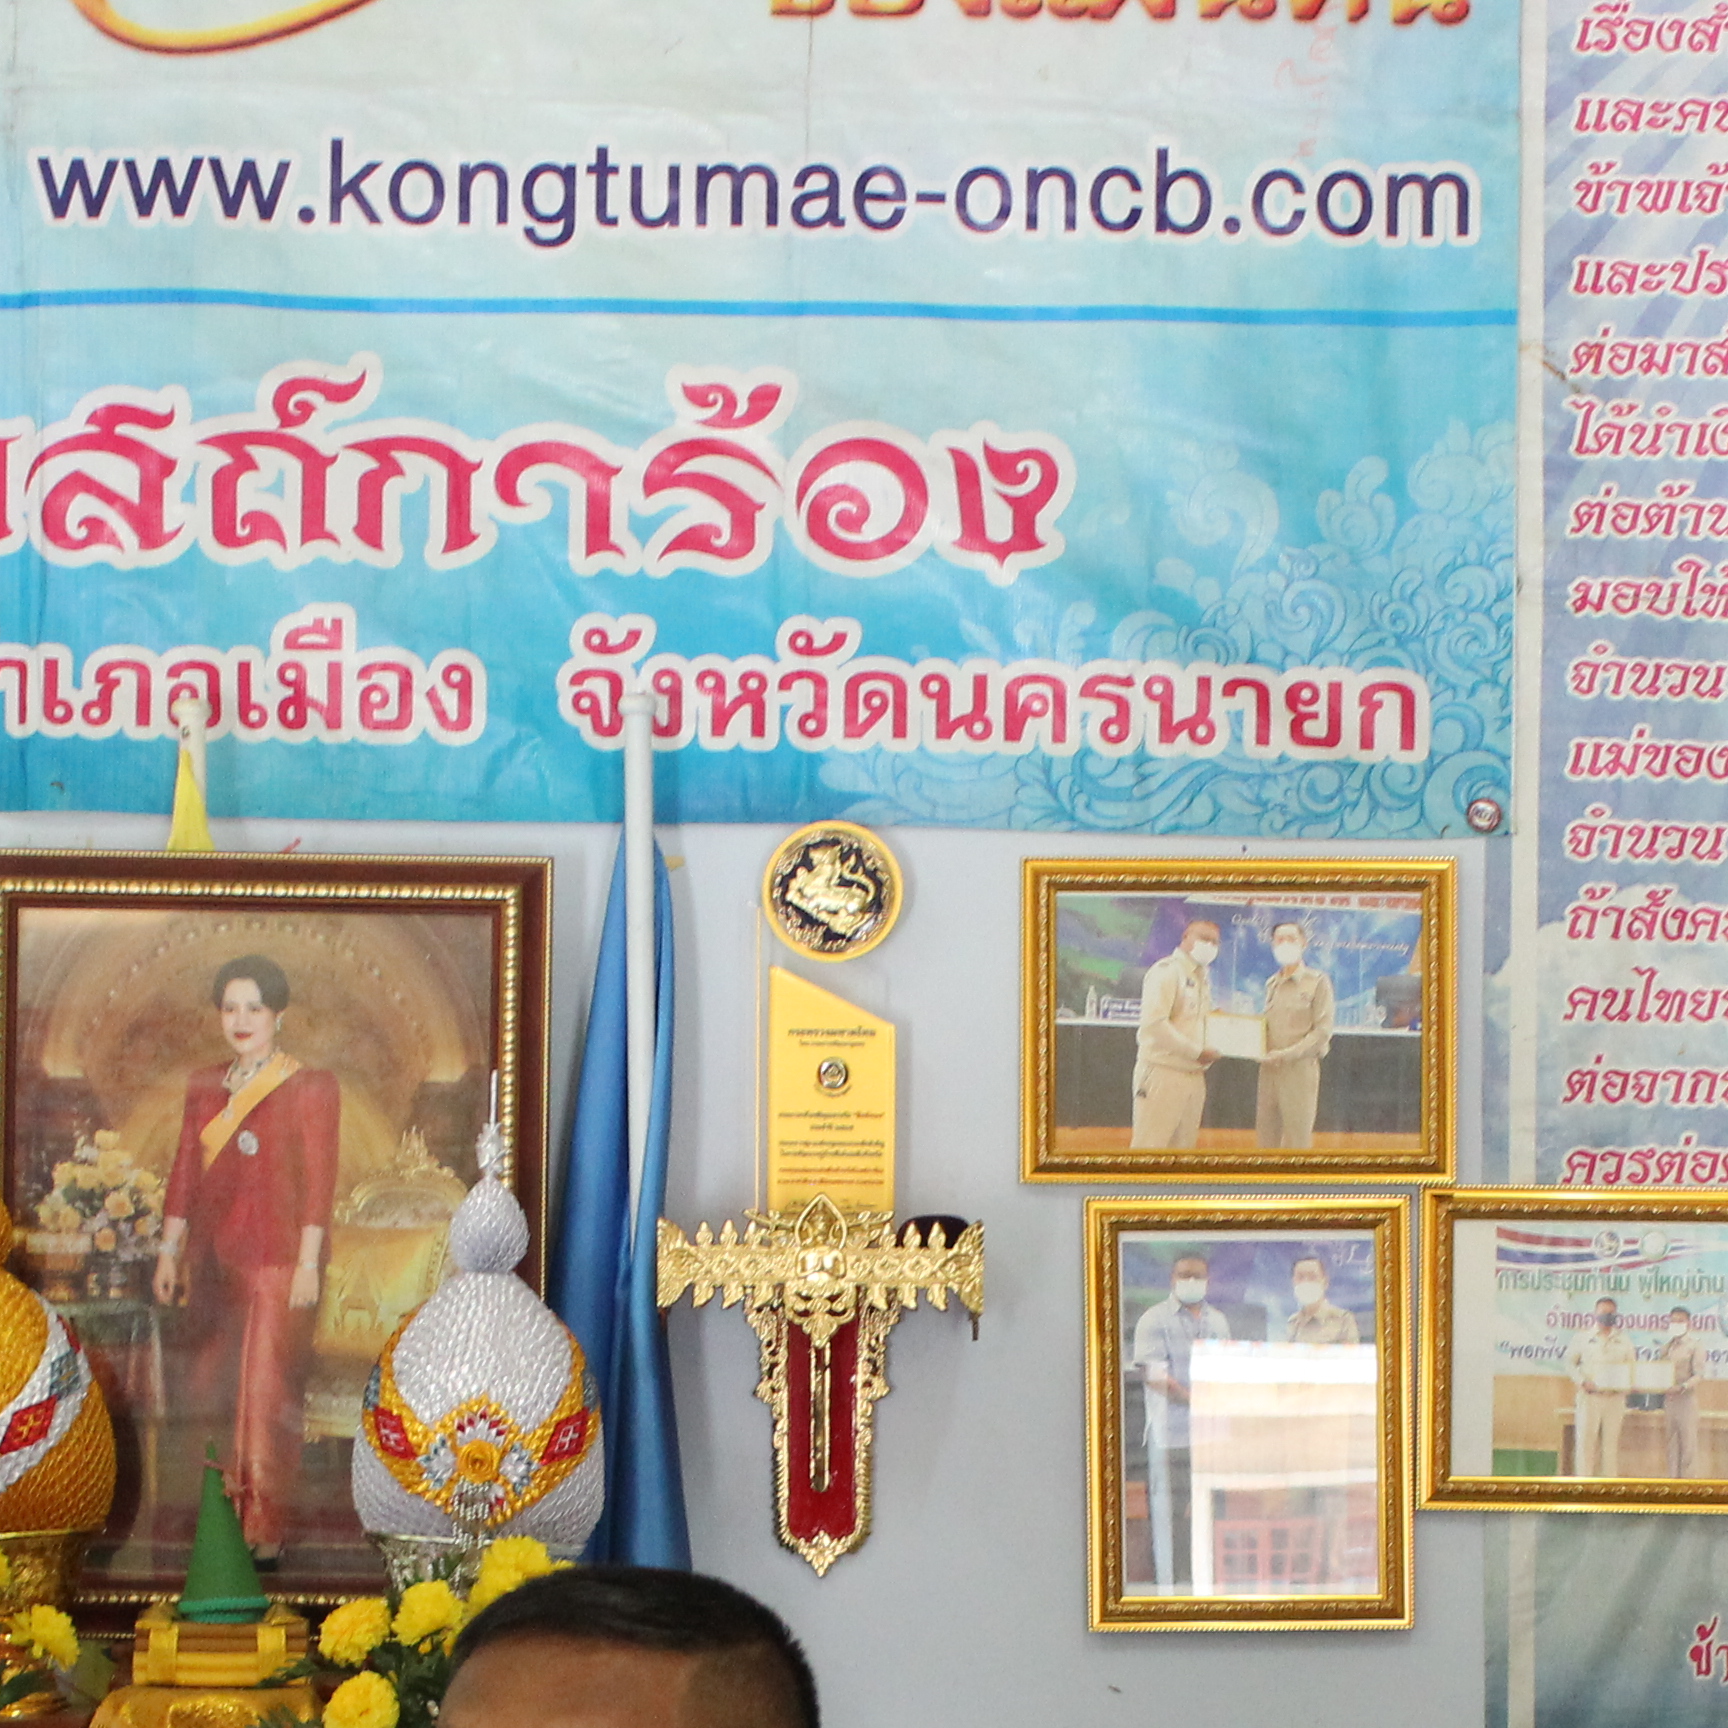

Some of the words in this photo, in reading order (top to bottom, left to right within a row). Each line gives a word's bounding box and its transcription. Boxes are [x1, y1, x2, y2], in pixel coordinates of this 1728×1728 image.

[36, 139, 1473, 249] www.kongtumae-oncb.com
[572, 630, 1414, 749] จังหวัดนครนายก
[1572, 643, 1726, 699] จำนวน
[1569, 808, 1725, 860] จำนวน
